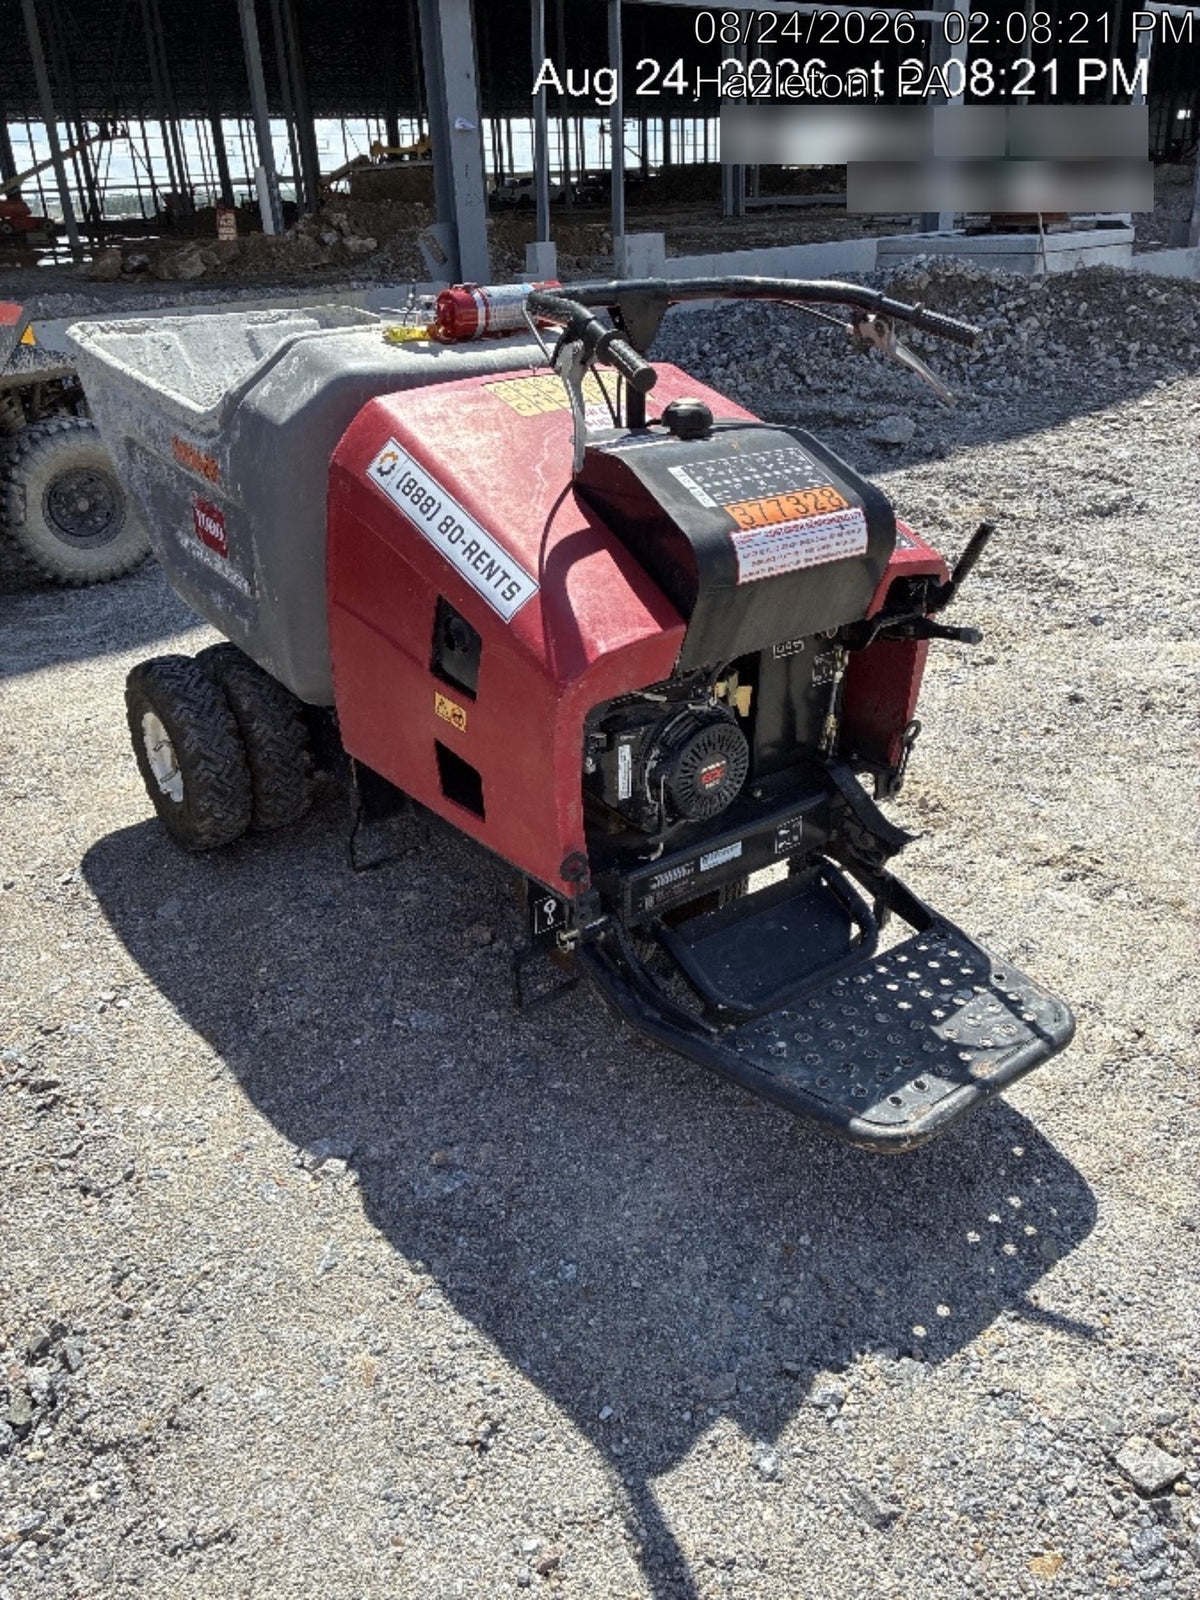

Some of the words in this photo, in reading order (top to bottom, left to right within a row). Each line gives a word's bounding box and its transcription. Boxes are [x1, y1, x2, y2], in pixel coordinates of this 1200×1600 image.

[396, 470, 441, 522] (888)
[437, 515, 522, 602] 80-RENTS
[731, 488, 844, 527] 377328
